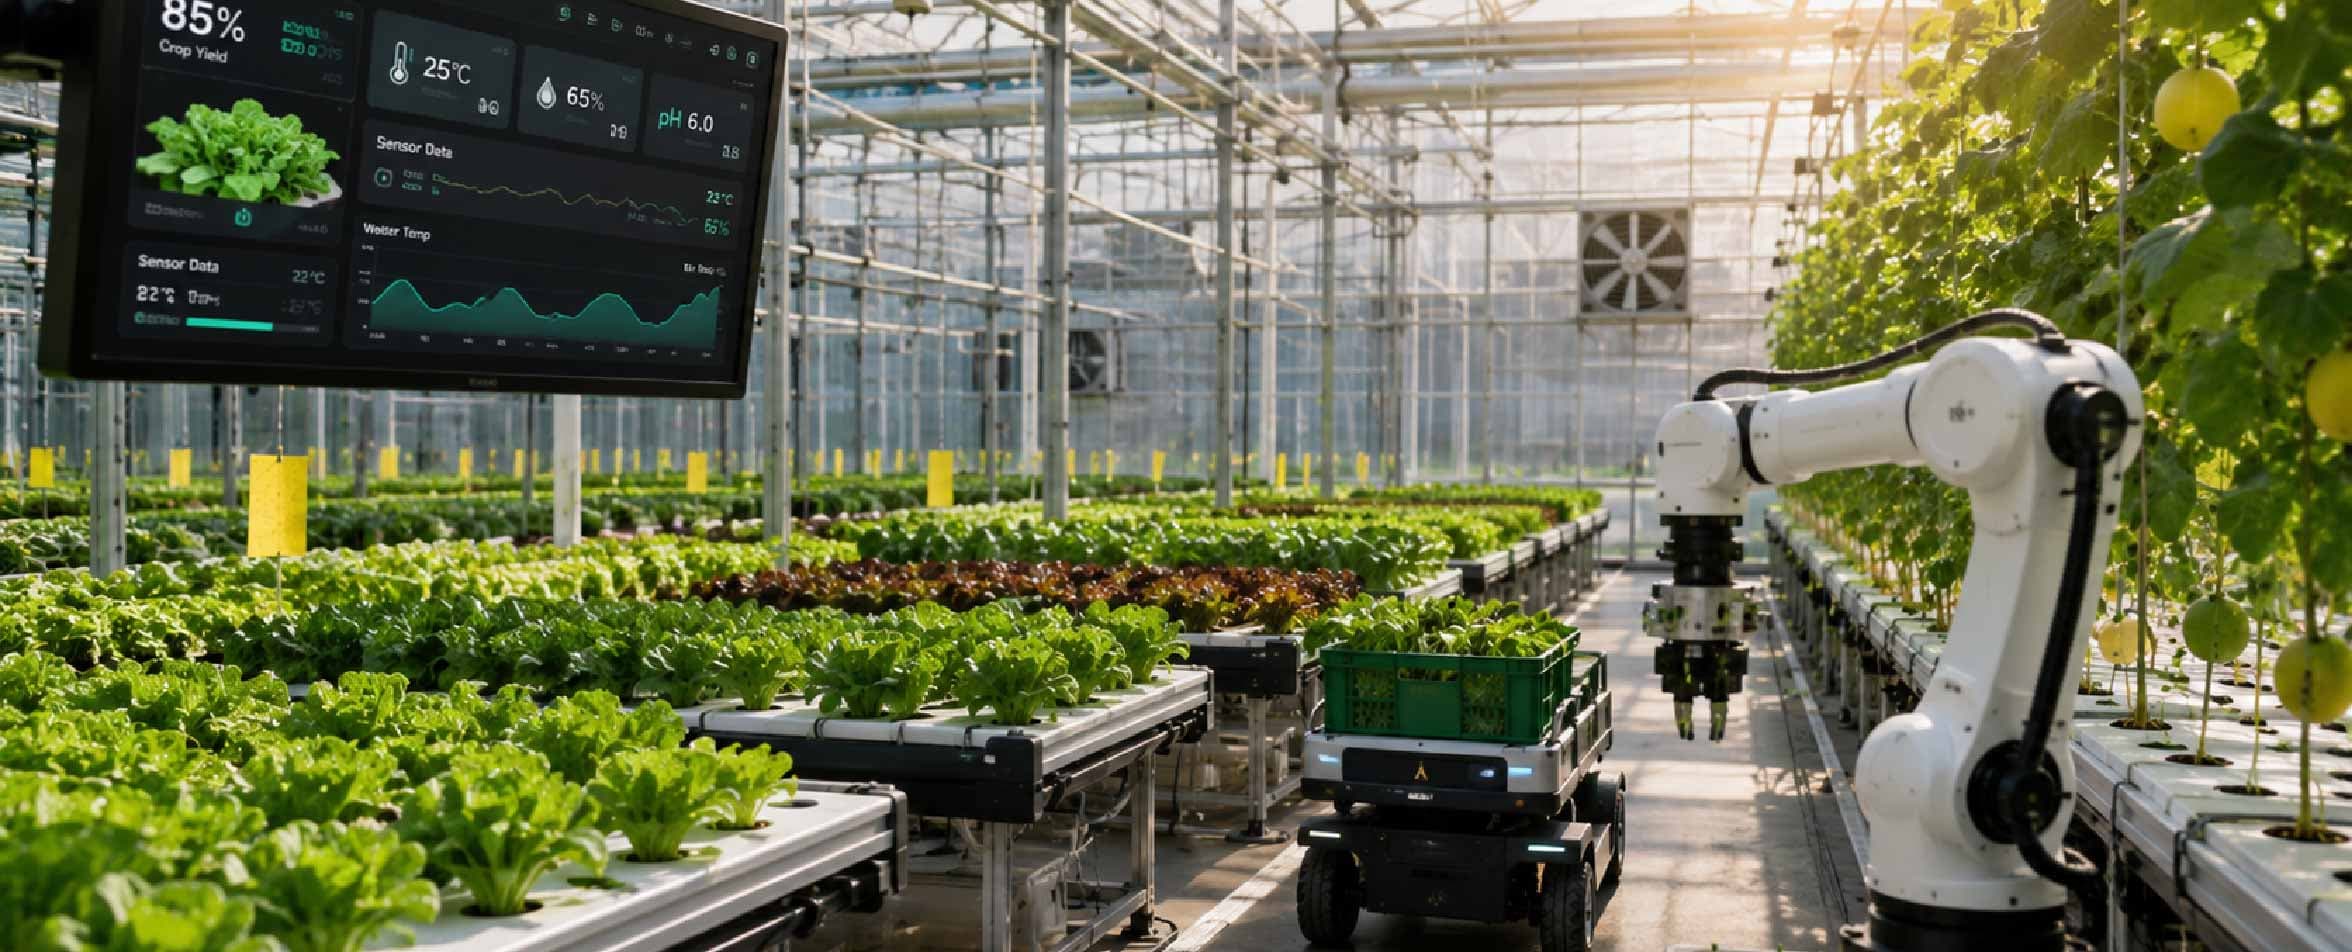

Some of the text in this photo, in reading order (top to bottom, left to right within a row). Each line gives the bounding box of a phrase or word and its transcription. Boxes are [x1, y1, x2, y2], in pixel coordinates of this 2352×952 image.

[162, 0, 245, 42] 85%
[159, 38, 229, 63] Crop Yield
[423, 56, 471, 84] 25°C
[566, 86, 604, 112] 65%
[657, 107, 714, 133] pH 6.0
[377, 135, 422, 154] Sensor
[403, 226, 431, 242] Temp
[138, 254, 219, 274] Sensor Data
